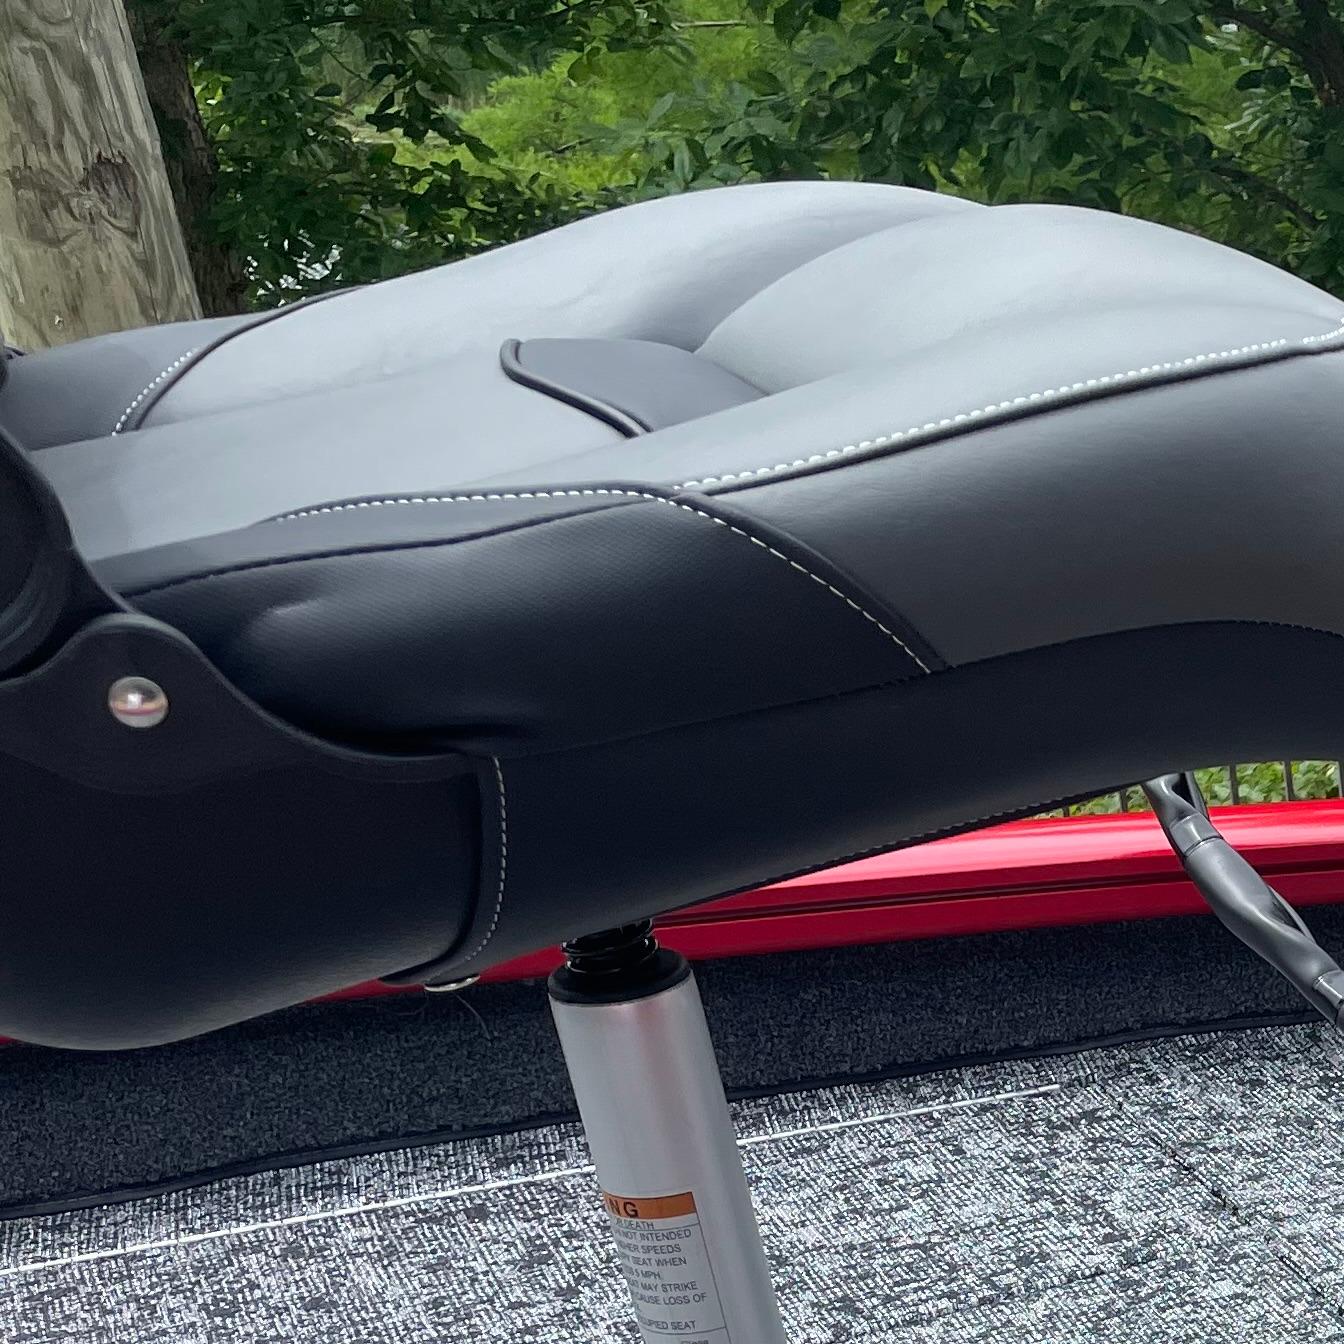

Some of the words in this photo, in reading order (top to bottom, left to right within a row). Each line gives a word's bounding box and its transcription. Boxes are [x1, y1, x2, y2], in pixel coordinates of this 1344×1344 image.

[640, 1228, 692, 1242] INTENDED
[641, 1243, 682, 1255] SPEEDS
[655, 1256, 687, 1267] WHEN
[640, 1282, 658, 1292] MAY
[660, 1280, 698, 1293] STRIKE
[663, 1295, 691, 1306] LOSS
[693, 1292, 707, 1304] OF
[670, 1319, 697, 1331] SEAT
